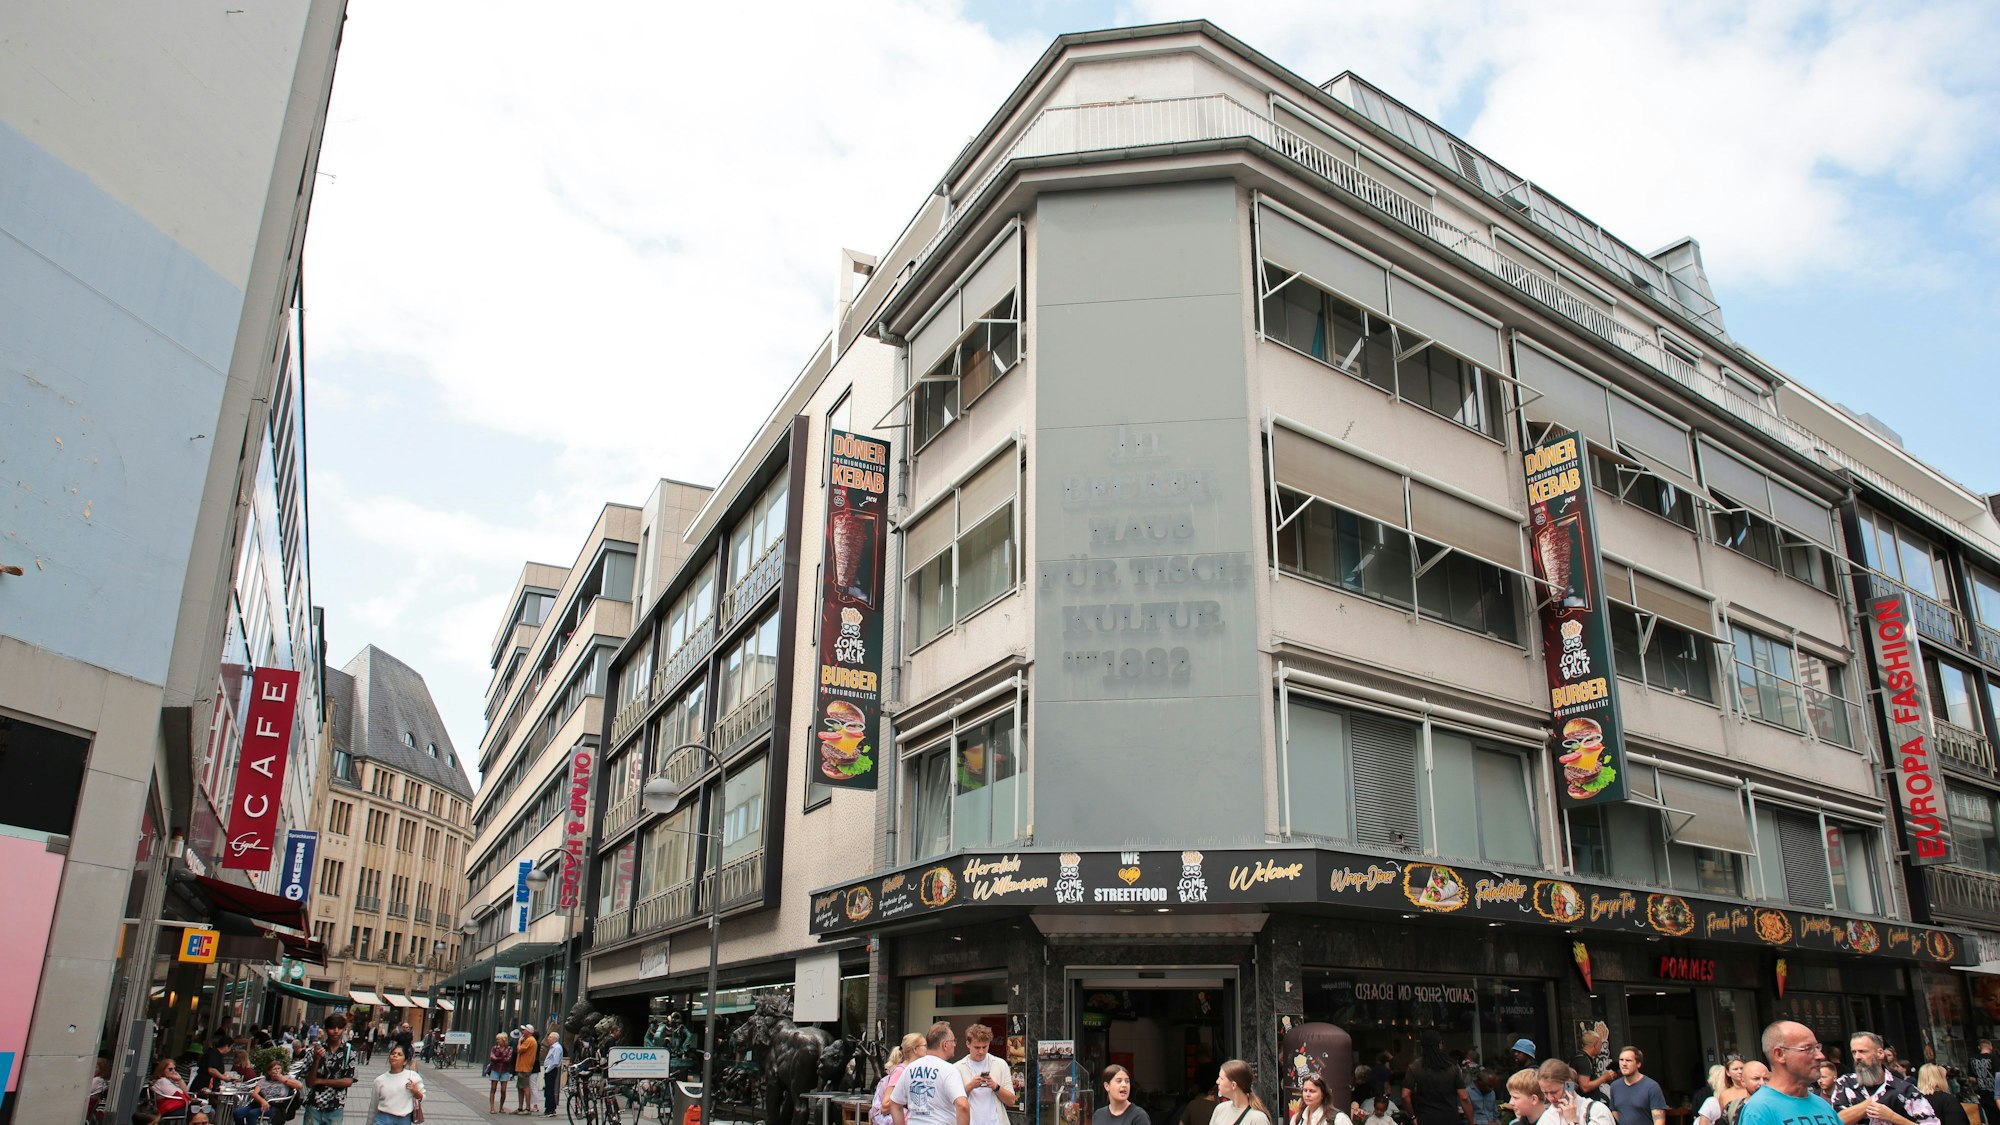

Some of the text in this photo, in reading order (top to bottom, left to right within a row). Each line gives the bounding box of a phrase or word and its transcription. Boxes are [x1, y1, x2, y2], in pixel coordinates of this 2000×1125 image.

[833, 434, 886, 465] DÖNER
[1525, 438, 1577, 476] DÖNER
[832, 456, 886, 473] PREMIUMQUALITÄT
[1527, 460, 1578, 484] PREMIUMQUALITÄT
[832, 464, 885, 494] KEBAB
[1529, 468, 1581, 507] KEBAB
[1039, 553, 1252, 588] FÜR TISCH
[1062, 600, 1226, 634] KULTUR
[835, 636, 864, 651] COME
[836, 648, 864, 664] BACK
[1102, 646, 1191, 679] 1882
[1561, 650, 1589, 667] COME
[1562, 660, 1590, 681] BACK
[822, 665, 877, 692] BURGER
[821, 686, 877, 700] PREMIUMQUALITÄT
[1552, 677, 1608, 709] BURGER
[1554, 699, 1609, 718] PREMIUMQUALITÄT
[1875, 599, 1946, 858] EUROPA FASHION
[244, 681, 289, 818] CAFE
[569, 752, 592, 819] OLYMP
[567, 820, 585, 836] &
[292, 842, 306, 884] KERN
[963, 854, 1022, 883] Herzlich
[1121, 851, 1140, 865] WE
[972, 874, 1048, 901] Willkommen
[1055, 879, 1083, 892] COME
[1178, 878, 1206, 891] COME
[1229, 859, 1303, 891] Welcome
[1056, 890, 1084, 903] BACK
[1094, 887, 1168, 902] STREETFOOD
[1179, 889, 1208, 903] BACK
[1731, 908, 1748, 935] Fries
[1659, 955, 1716, 981] POMMES
[620, 1052, 657, 1061] OCURA
[909, 1066, 939, 1080] VANS
